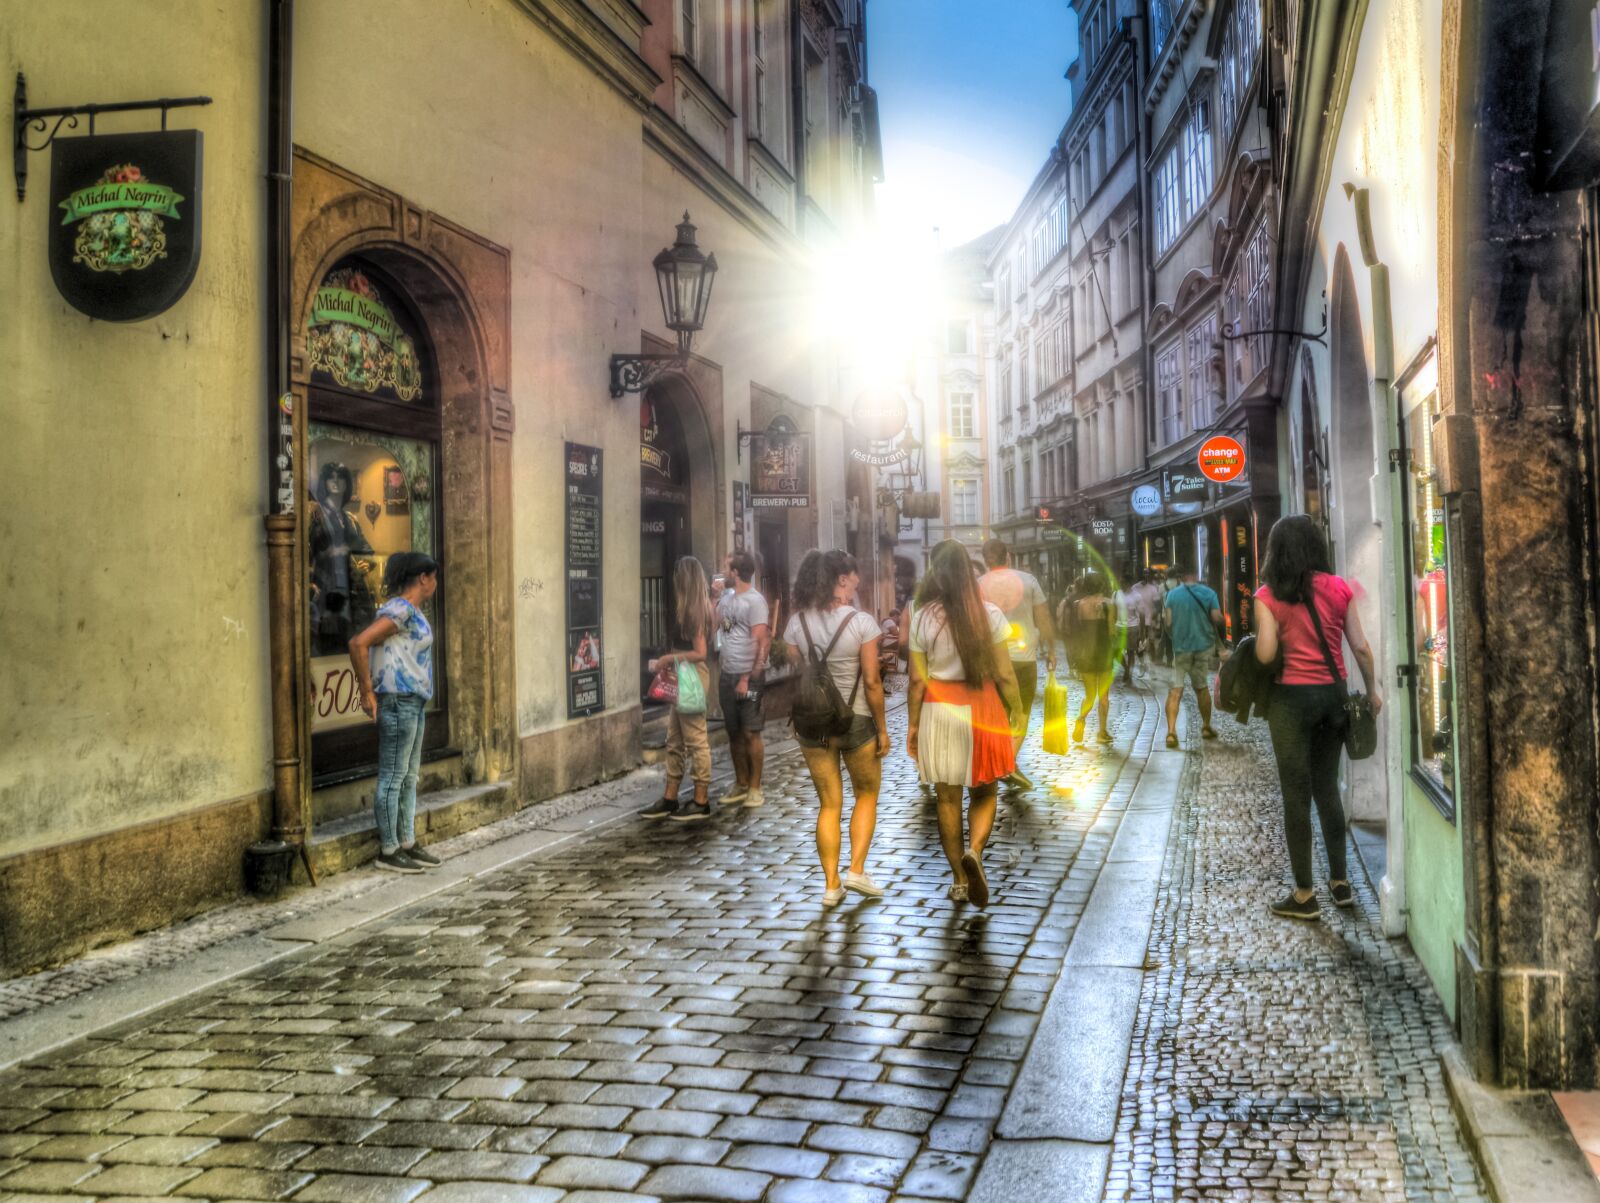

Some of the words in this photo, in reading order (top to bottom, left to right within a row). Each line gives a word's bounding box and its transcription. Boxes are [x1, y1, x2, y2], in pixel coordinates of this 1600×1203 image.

[78, 185, 121, 208] Michal
[124, 187, 167, 206] Negrin
[317, 291, 355, 314] Michal
[357, 301, 391, 332] Negrin
[850, 449, 907, 464] restaurant
[1203, 448, 1239, 458] change
[1172, 475, 1185, 494] 7
[1185, 477, 1205, 485] Tales
[1182, 482, 1205, 490] Suites
[752, 498, 788, 507] BREWERY
[791, 498, 808, 507] PUB
[1135, 491, 1158, 504] local
[1092, 520, 1114, 528] KOSTA
